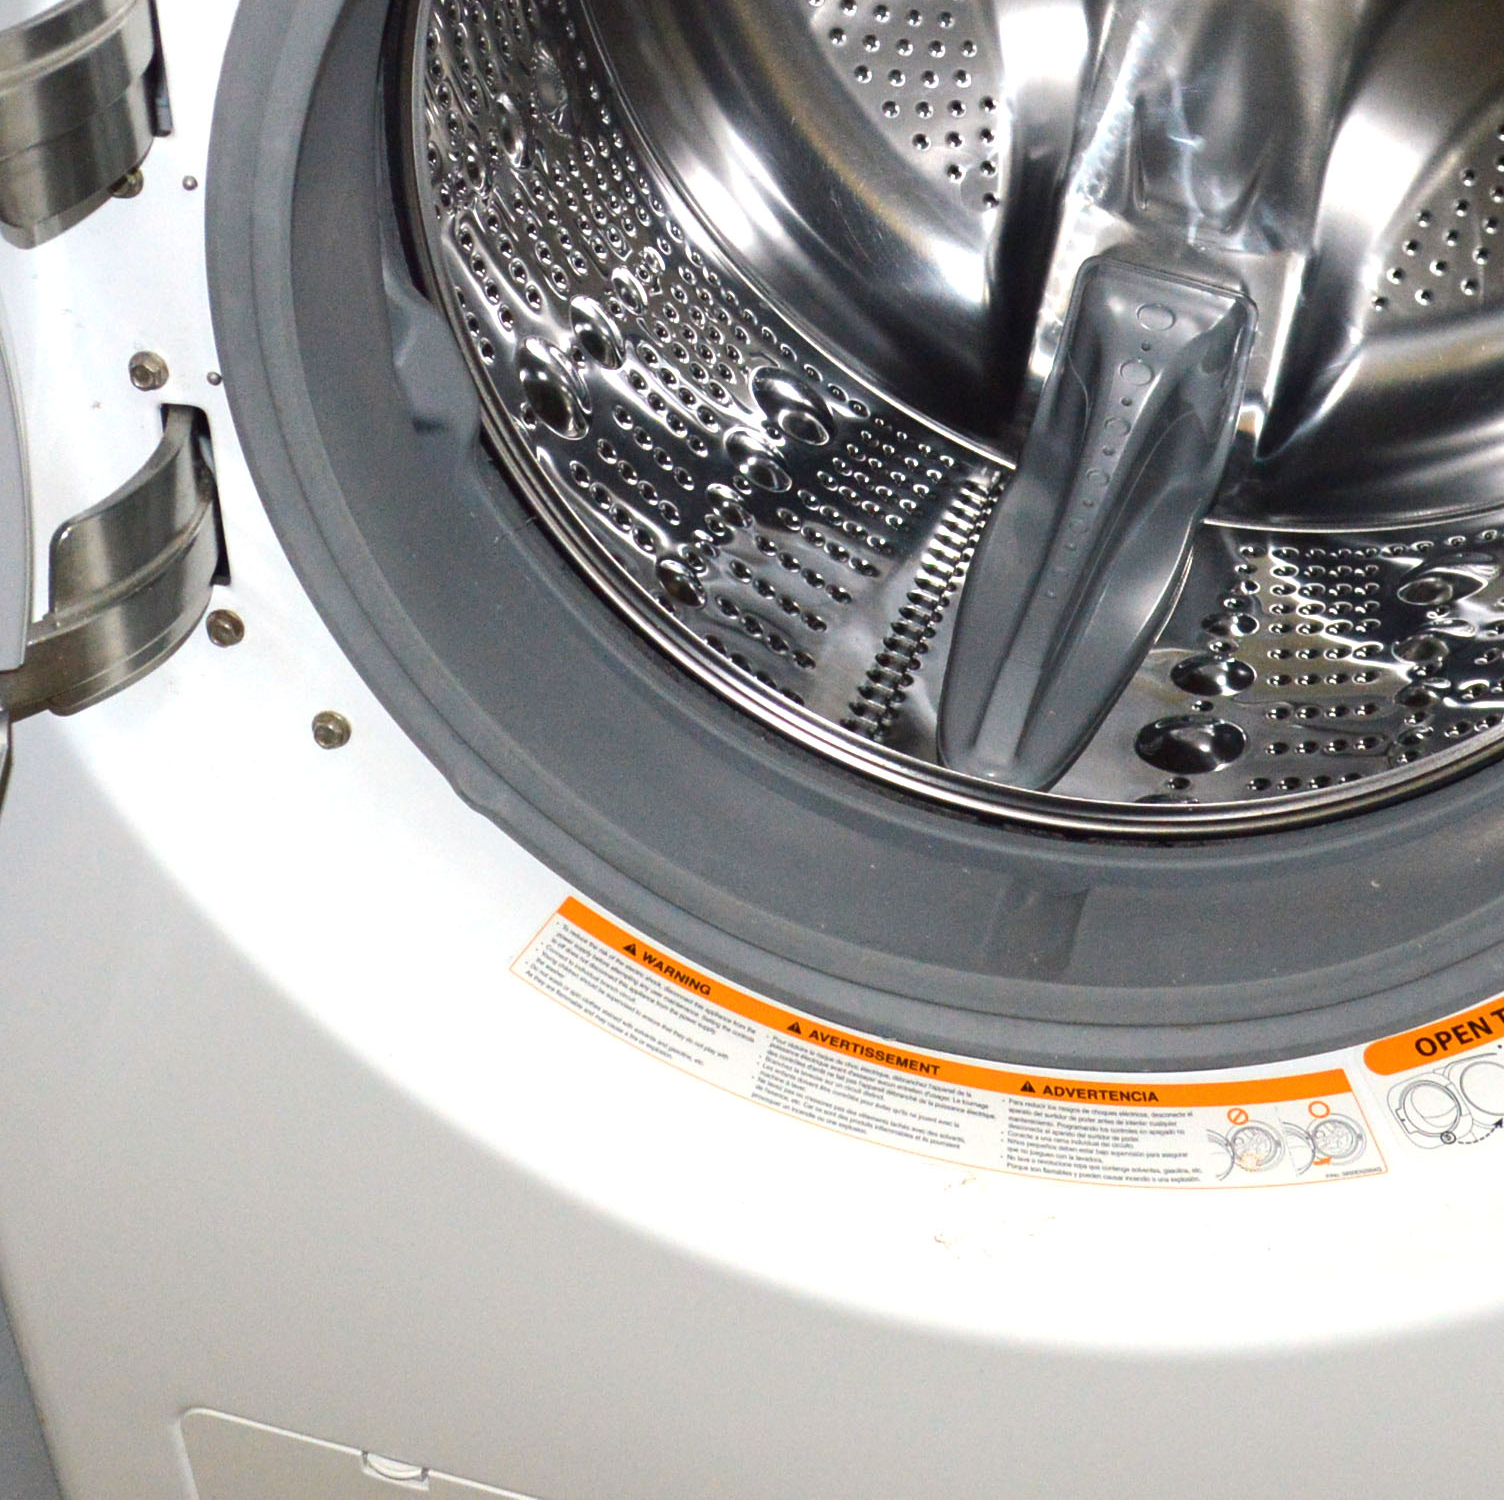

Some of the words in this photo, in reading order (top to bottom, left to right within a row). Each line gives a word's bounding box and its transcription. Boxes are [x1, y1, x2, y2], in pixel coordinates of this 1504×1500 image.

[643, 952, 710, 995] WARNING
[809, 1031, 939, 1074] AVERTISSEMENT
[1415, 1017, 1493, 1056] OPEN
[1043, 1086, 1158, 1101] ADVERTENCIA
